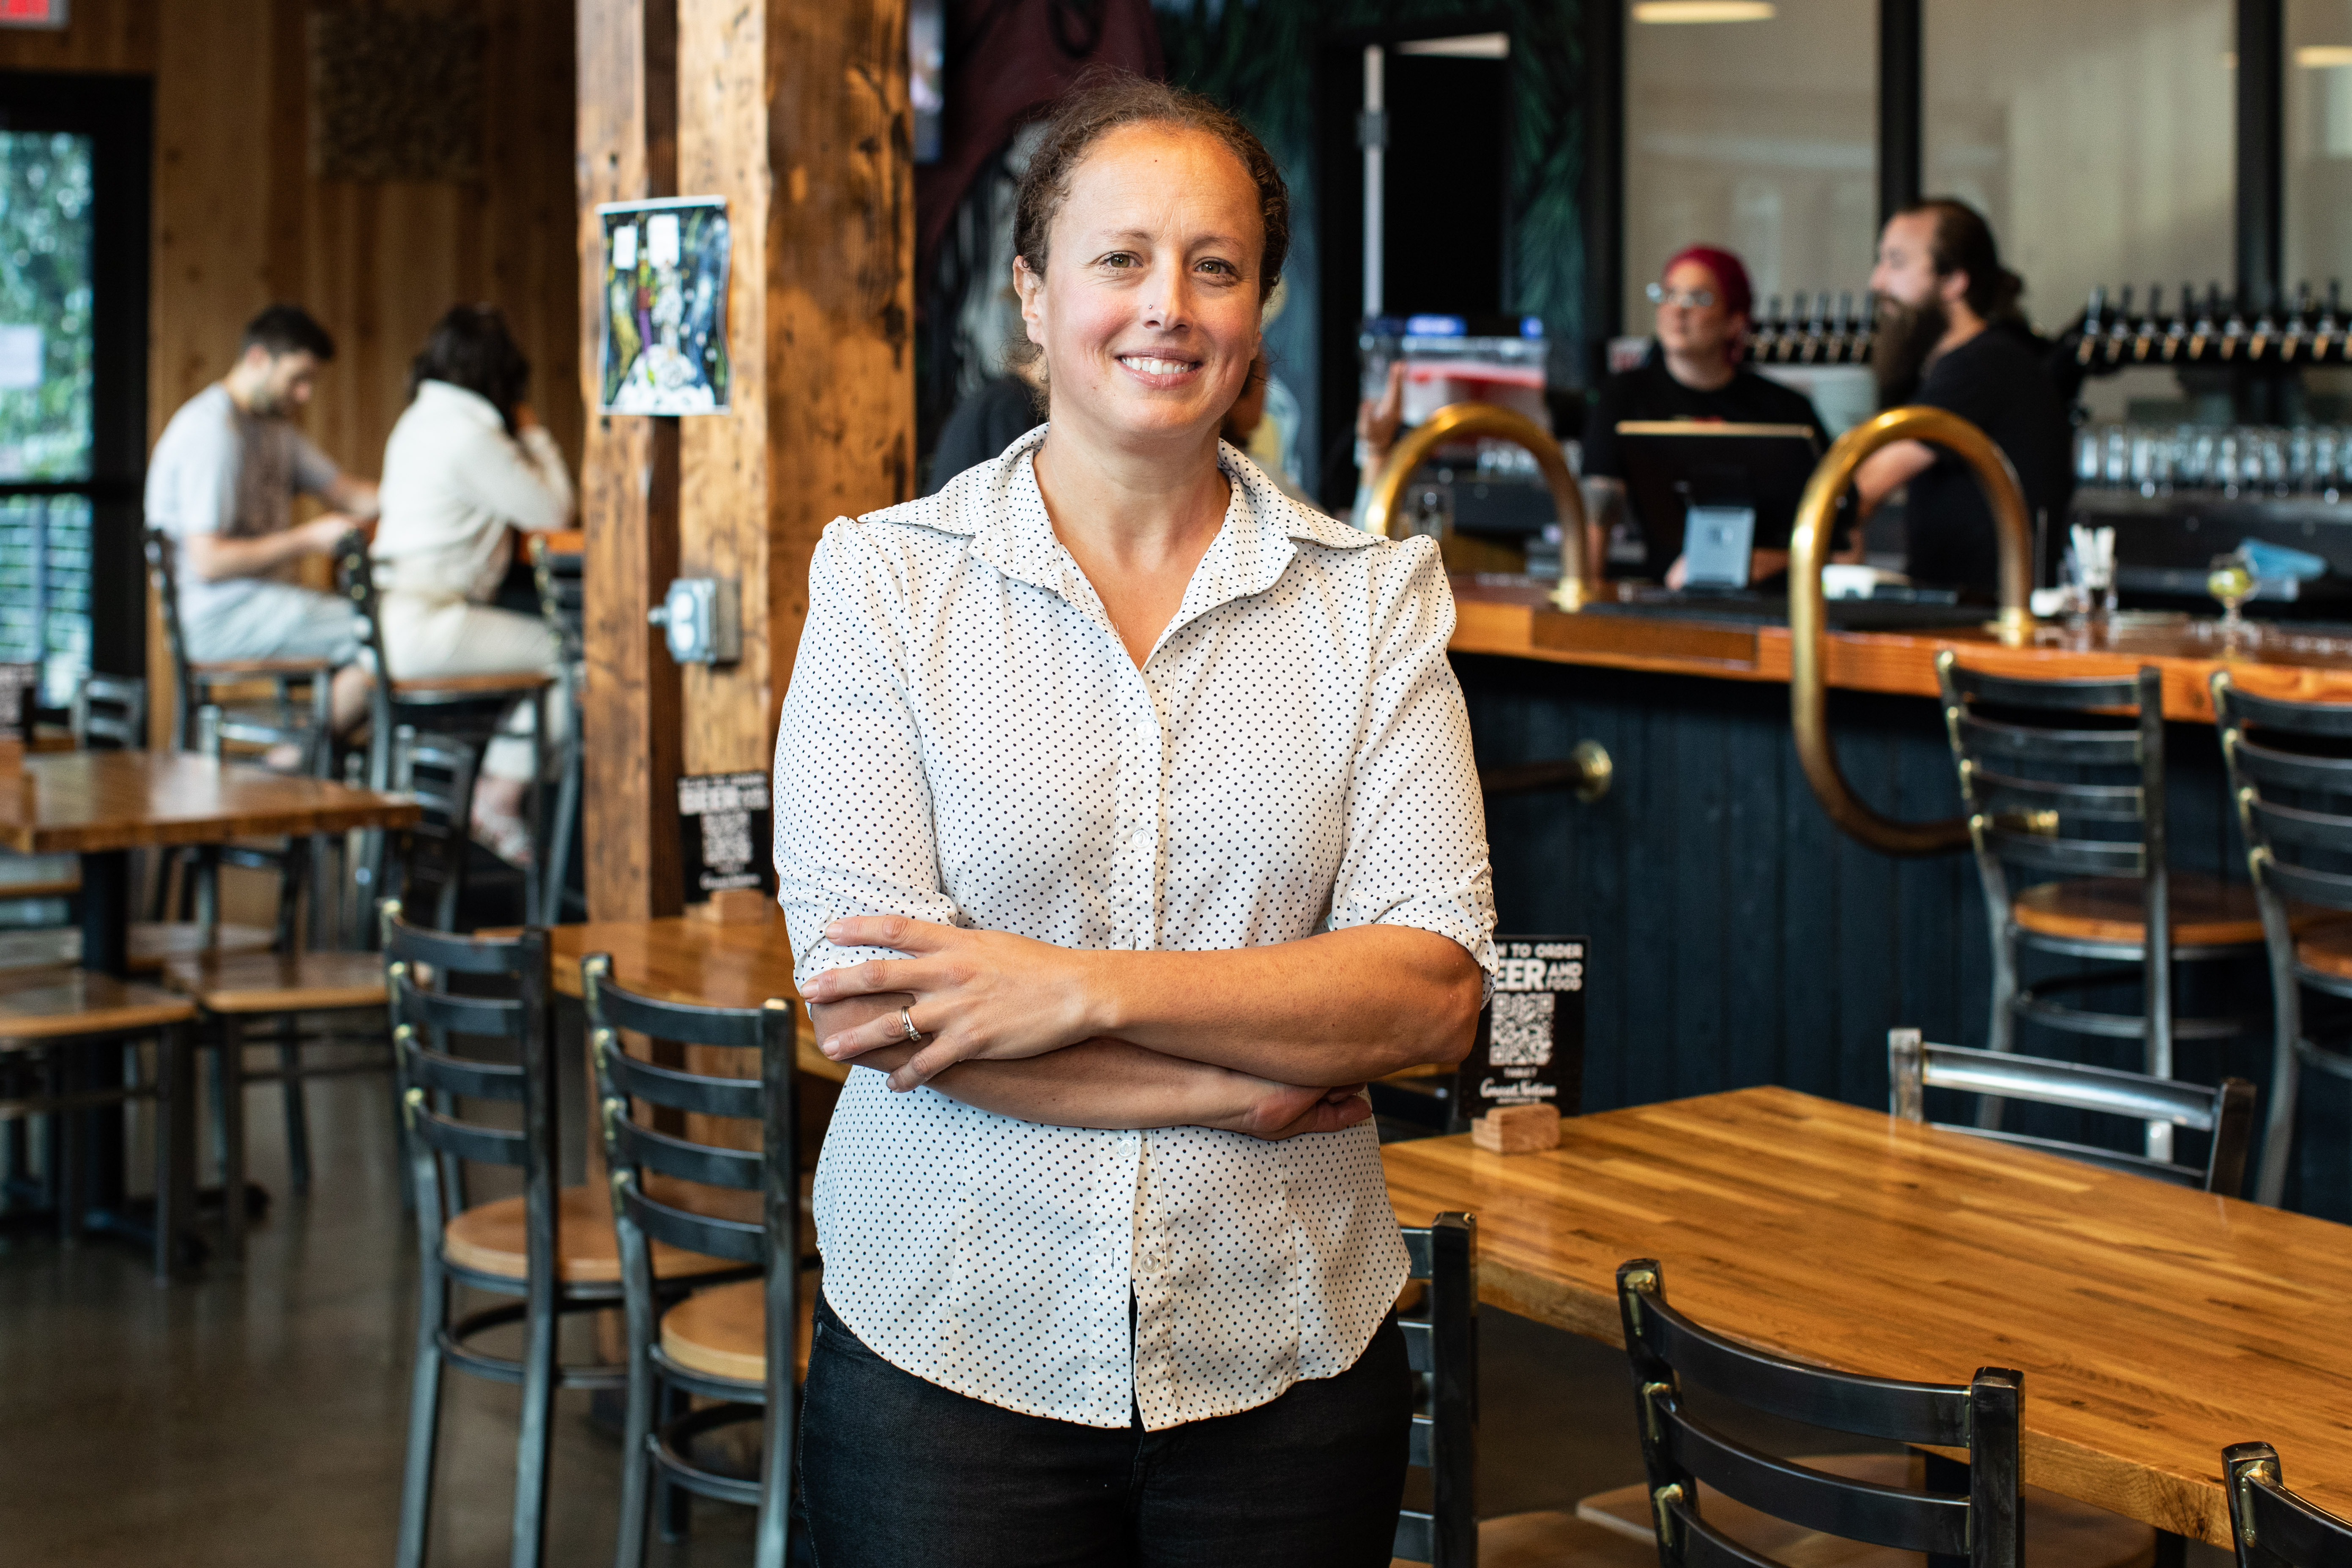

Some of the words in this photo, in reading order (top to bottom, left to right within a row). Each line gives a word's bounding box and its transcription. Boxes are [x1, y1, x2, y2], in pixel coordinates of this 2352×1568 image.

[1510, 943, 1532, 958] TO
[1534, 943, 1583, 959] ORDER
[1497, 958, 1547, 991] EER
